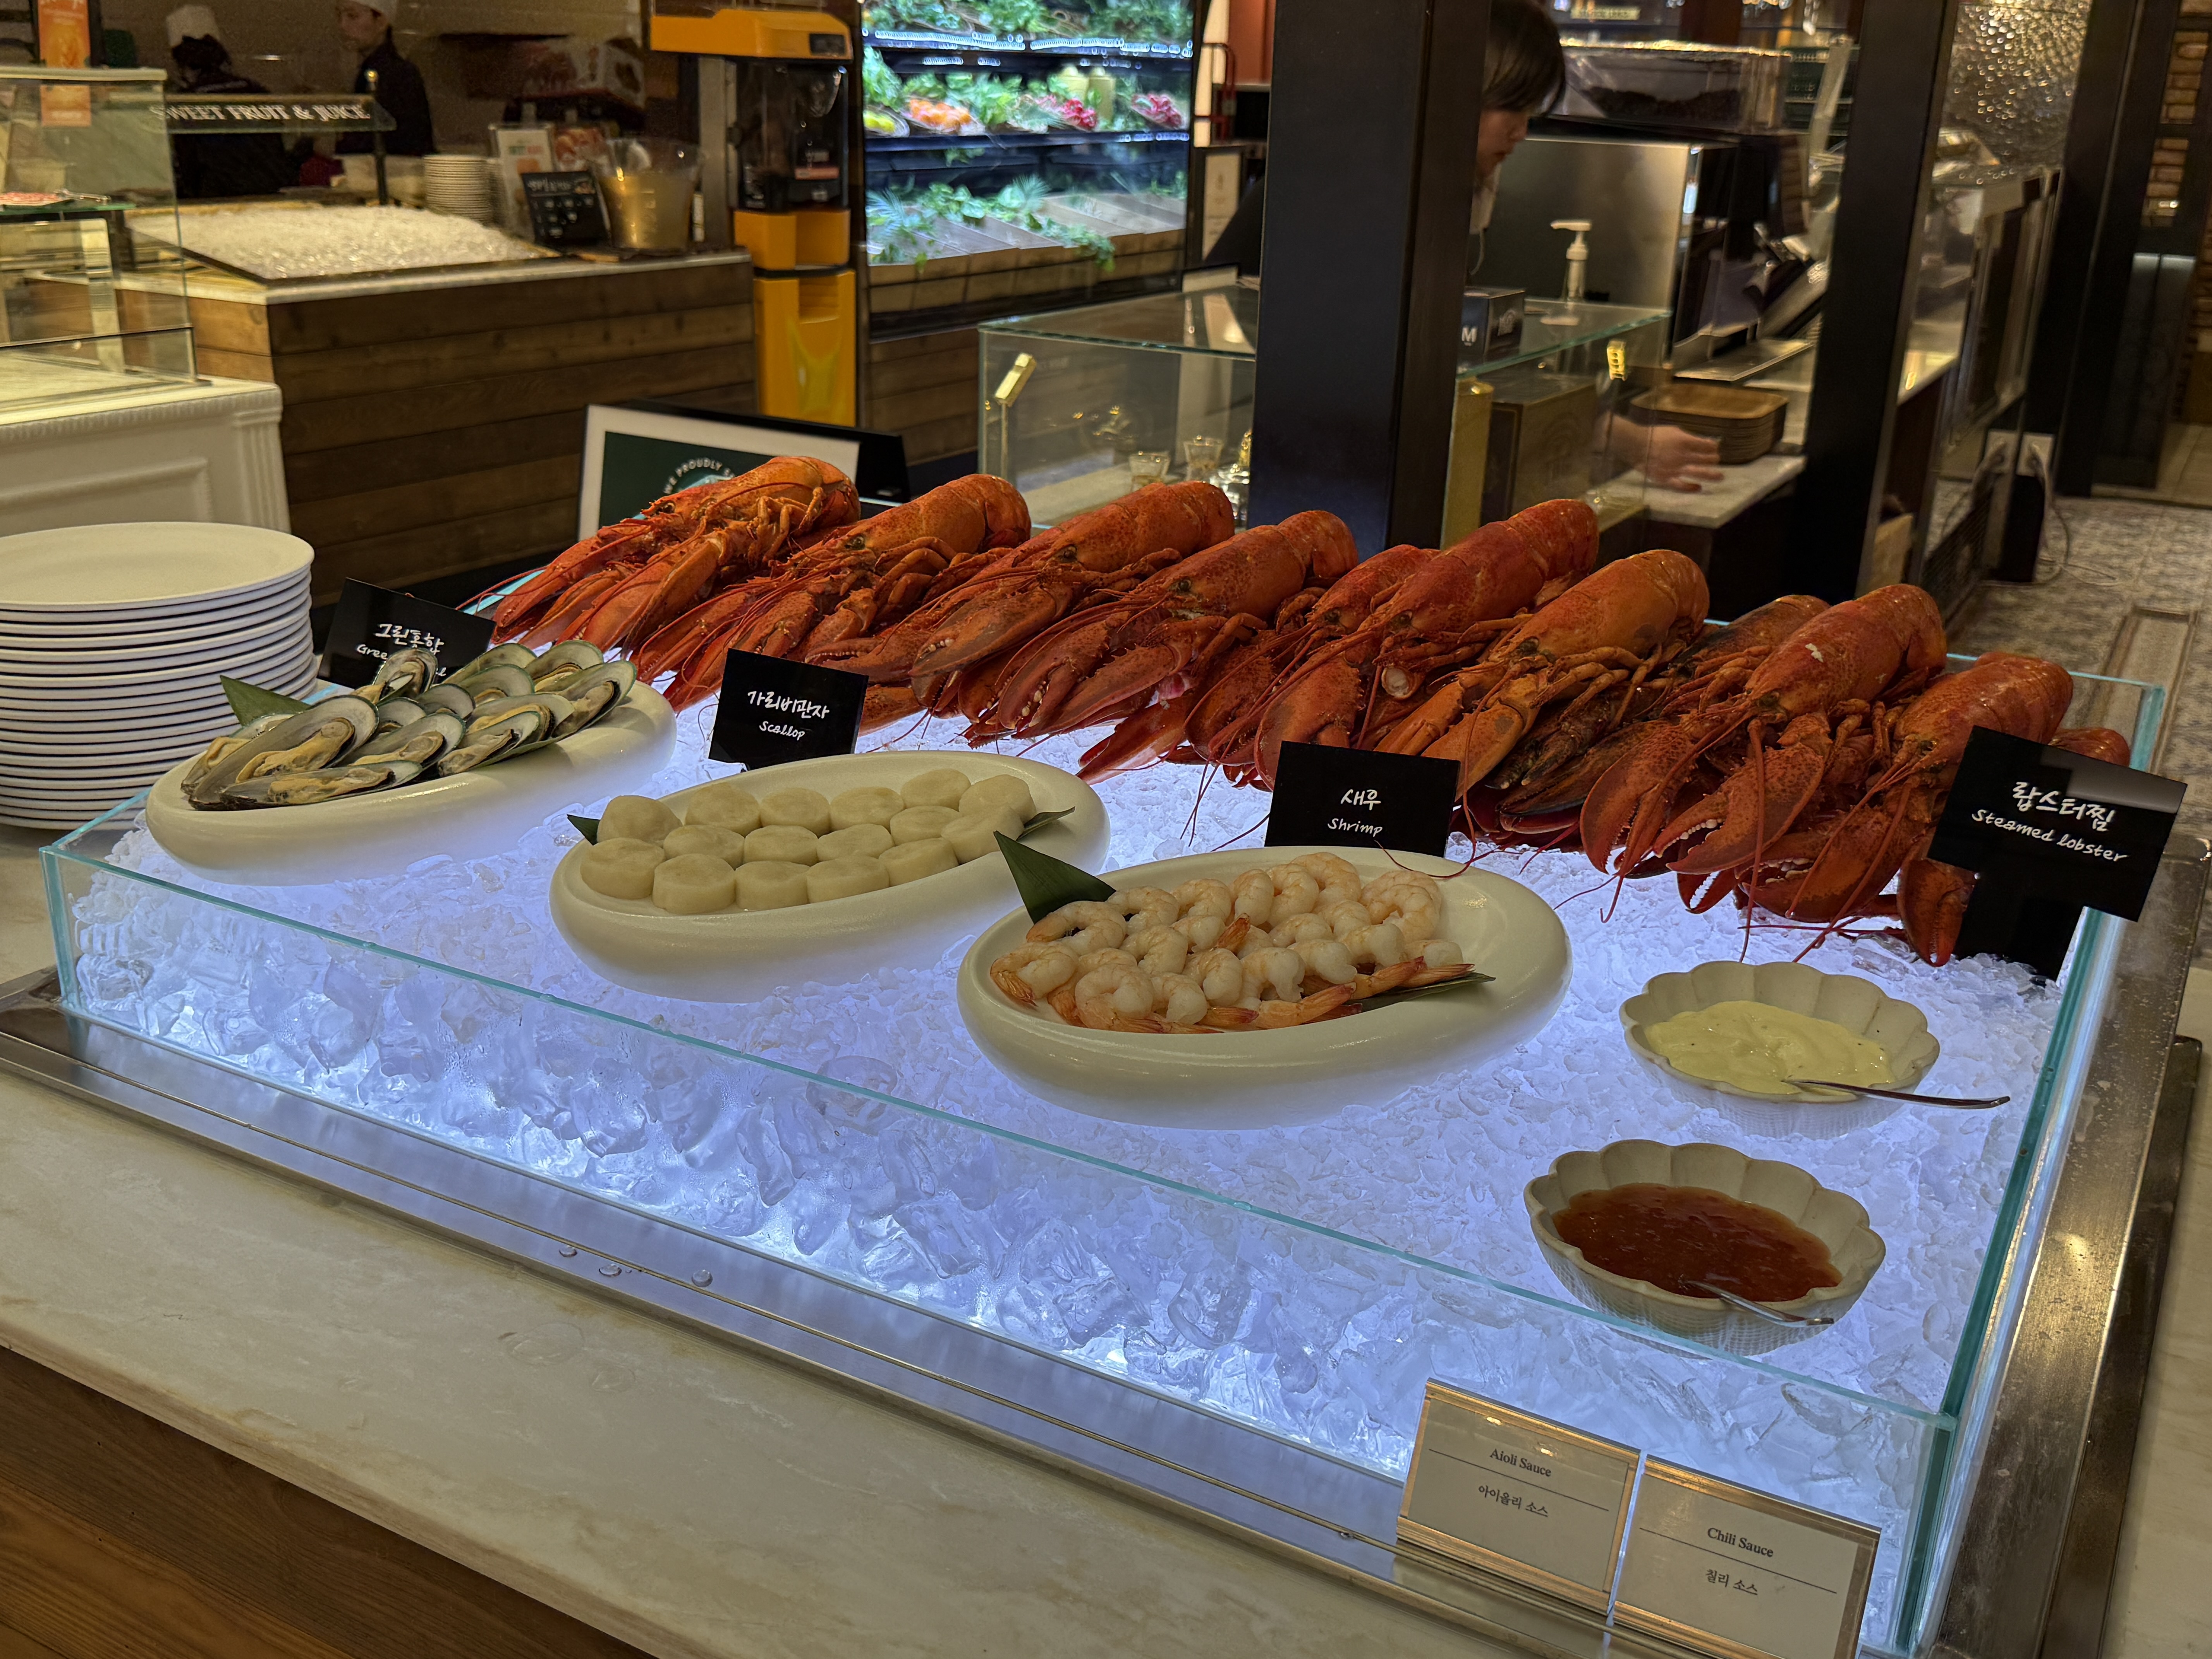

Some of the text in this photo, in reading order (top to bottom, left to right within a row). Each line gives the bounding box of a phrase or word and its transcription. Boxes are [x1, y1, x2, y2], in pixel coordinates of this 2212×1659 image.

[151, 104, 371, 122] SWEET FRUIT & JUICE
[663, 476, 677, 494] WE
[675, 457, 723, 477] PROUDLY
[356, 644, 388, 660] Gree
[747, 691, 830, 719] 가리비관자
[759, 720, 805, 741] Scallop
[1340, 788, 1381, 811] 새우
[2013, 781, 2116, 832] 랍스터찜
[1327, 818, 1383, 837] Shrimp
[1972, 809, 2130, 862] Steamed lobster
[1489, 1448, 1551, 1477] Aioli Sauce
[1478, 1485, 1548, 1517] 아이올리 소스
[1707, 1527, 1774, 1558] Chili Sauce
[1705, 1569, 1758, 1595] 칠리 소스
